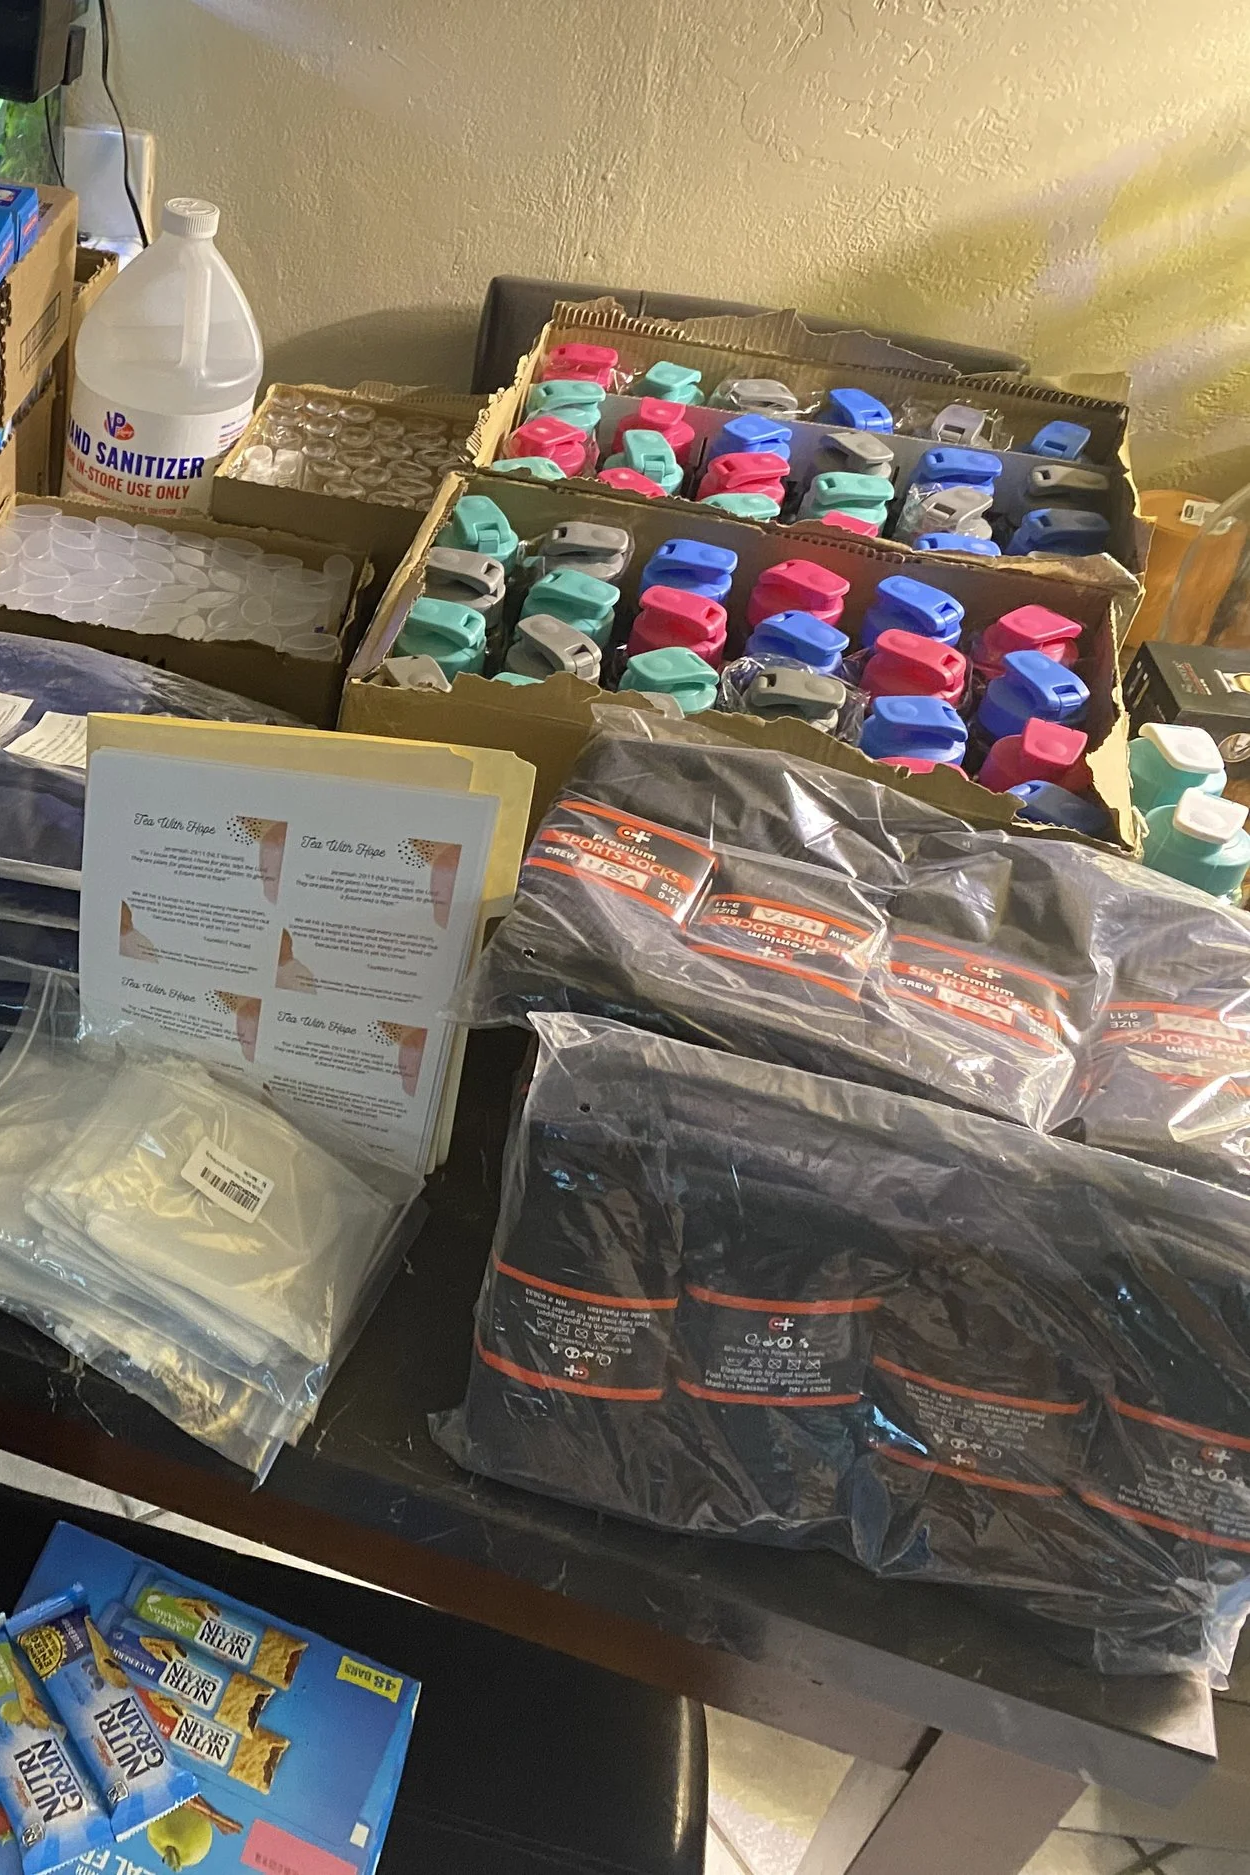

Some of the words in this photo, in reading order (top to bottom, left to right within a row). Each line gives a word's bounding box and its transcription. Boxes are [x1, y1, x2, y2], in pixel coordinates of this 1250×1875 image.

[96, 441, 205, 480] SANITIZER
[75, 457, 123, 492] IN-STORE
[126, 480, 152, 499] USE
[156, 484, 191, 500] ONLY
[133, 812, 155, 827] Tea
[157, 816, 185, 831] With
[186, 819, 217, 836] Hope
[301, 835, 323, 849] Tea
[326, 839, 353, 854] With
[355, 843, 386, 859] Hope
[545, 846, 579, 861] CREW
[560, 832, 623, 861] SPORTS
[628, 855, 681, 884] SOCKS
[592, 833, 657, 862] Premium
[658, 891, 681, 909] 9-11
[713, 907, 739, 916] SIZE
[715, 900, 741, 909] 9-11
[720, 916, 777, 936] SOCKS
[747, 930, 817, 955] Premium
[121, 976, 141, 989] Tea
[142, 982, 168, 996] With
[169, 988, 196, 1004] Hope
[897, 977, 935, 993] CREW
[909, 965, 982, 996] SPORTS
[942, 967, 1015, 997] Premium
[277, 1010, 298, 1024] Tea
[300, 1015, 327, 1030] With
[328, 1020, 358, 1036] Hope
[1109, 1011, 1139, 1020] 9-11
[1109, 1020, 1142, 1029] SIZE
[1129, 1031, 1195, 1047] SOCKS
[552, 1305, 576, 1317] greater
[563, 1316, 581, 1326] good
[586, 1305, 622, 1317] Pakistan
[630, 1310, 650, 1319] Made
[705, 1378, 725, 1388] Made
[775, 1371, 794, 1379] good
[794, 1371, 821, 1380] support
[780, 1377, 805, 1386] greater
[805, 1377, 831, 1385] comfort
[199, 1629, 248, 1661] NUTRI
[203, 1619, 252, 1649] GRAIN
[170, 1660, 218, 1693] GRAIN
[344, 1664, 372, 1682] BARS
[374, 1675, 397, 1691] 48
[163, 1672, 214, 1706] NUTRI
[109, 1696, 165, 1769] GRAIN
[181, 1714, 231, 1747] GRAIN
[94, 1709, 150, 1781] NUTRI
[175, 1727, 226, 1760] NUTRI
[13, 1746, 68, 1824] NUTRI
[30, 1738, 85, 1812] GRAIN
